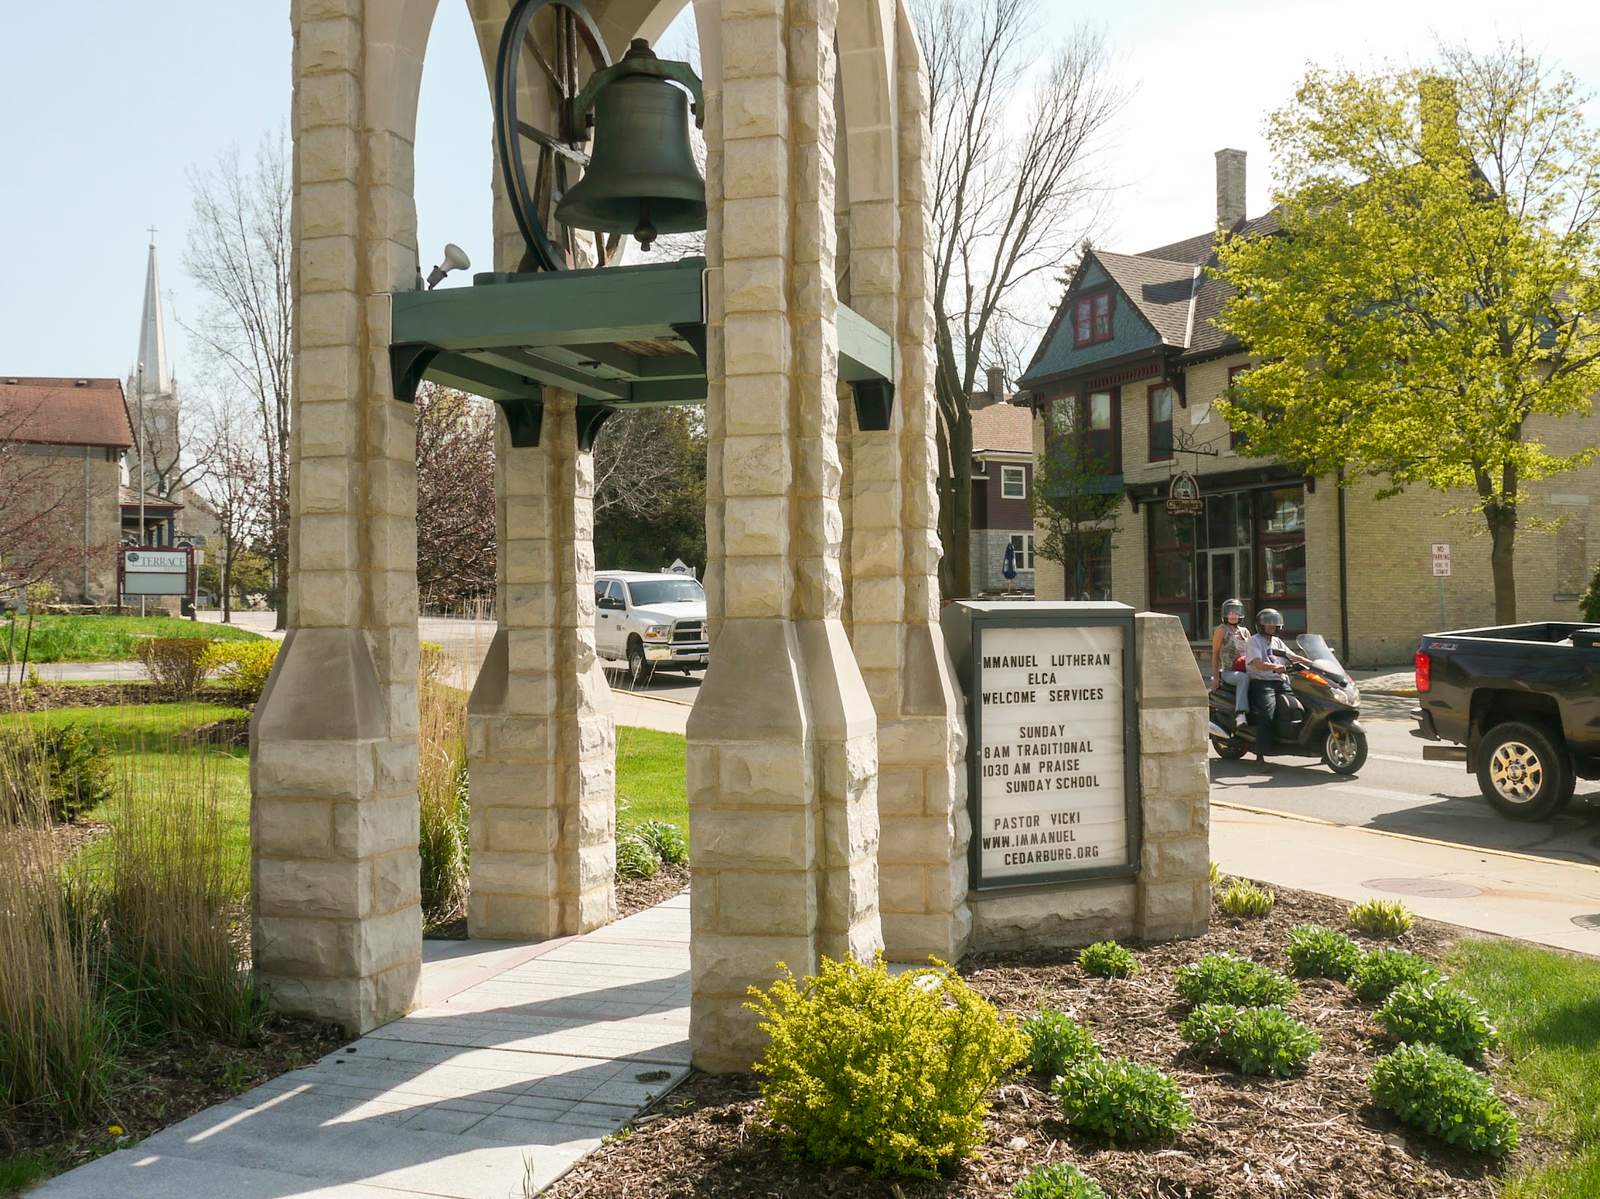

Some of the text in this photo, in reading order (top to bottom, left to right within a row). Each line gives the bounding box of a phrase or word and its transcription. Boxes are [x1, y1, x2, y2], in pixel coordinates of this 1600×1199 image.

[142, 556, 185, 568] TERRACE
[1051, 653, 1111, 667] LUTHERAN
[1028, 672, 1057, 685] ELCA
[982, 688, 1104, 705] WELCOME SERVICES
[1019, 725, 1065, 739] SUNDAY
[1017, 740, 1094, 757] TRADITIONAL
[983, 759, 1080, 777] 1030 AM PRAISE
[1006, 775, 1100, 794] SUNDAY SCHOOL
[994, 811, 1081, 830] PASTOR VICKI
[982, 830, 1076, 850] WWW.IMMANUEL
[1004, 846, 1099, 866] CEDARBURG.ORG
